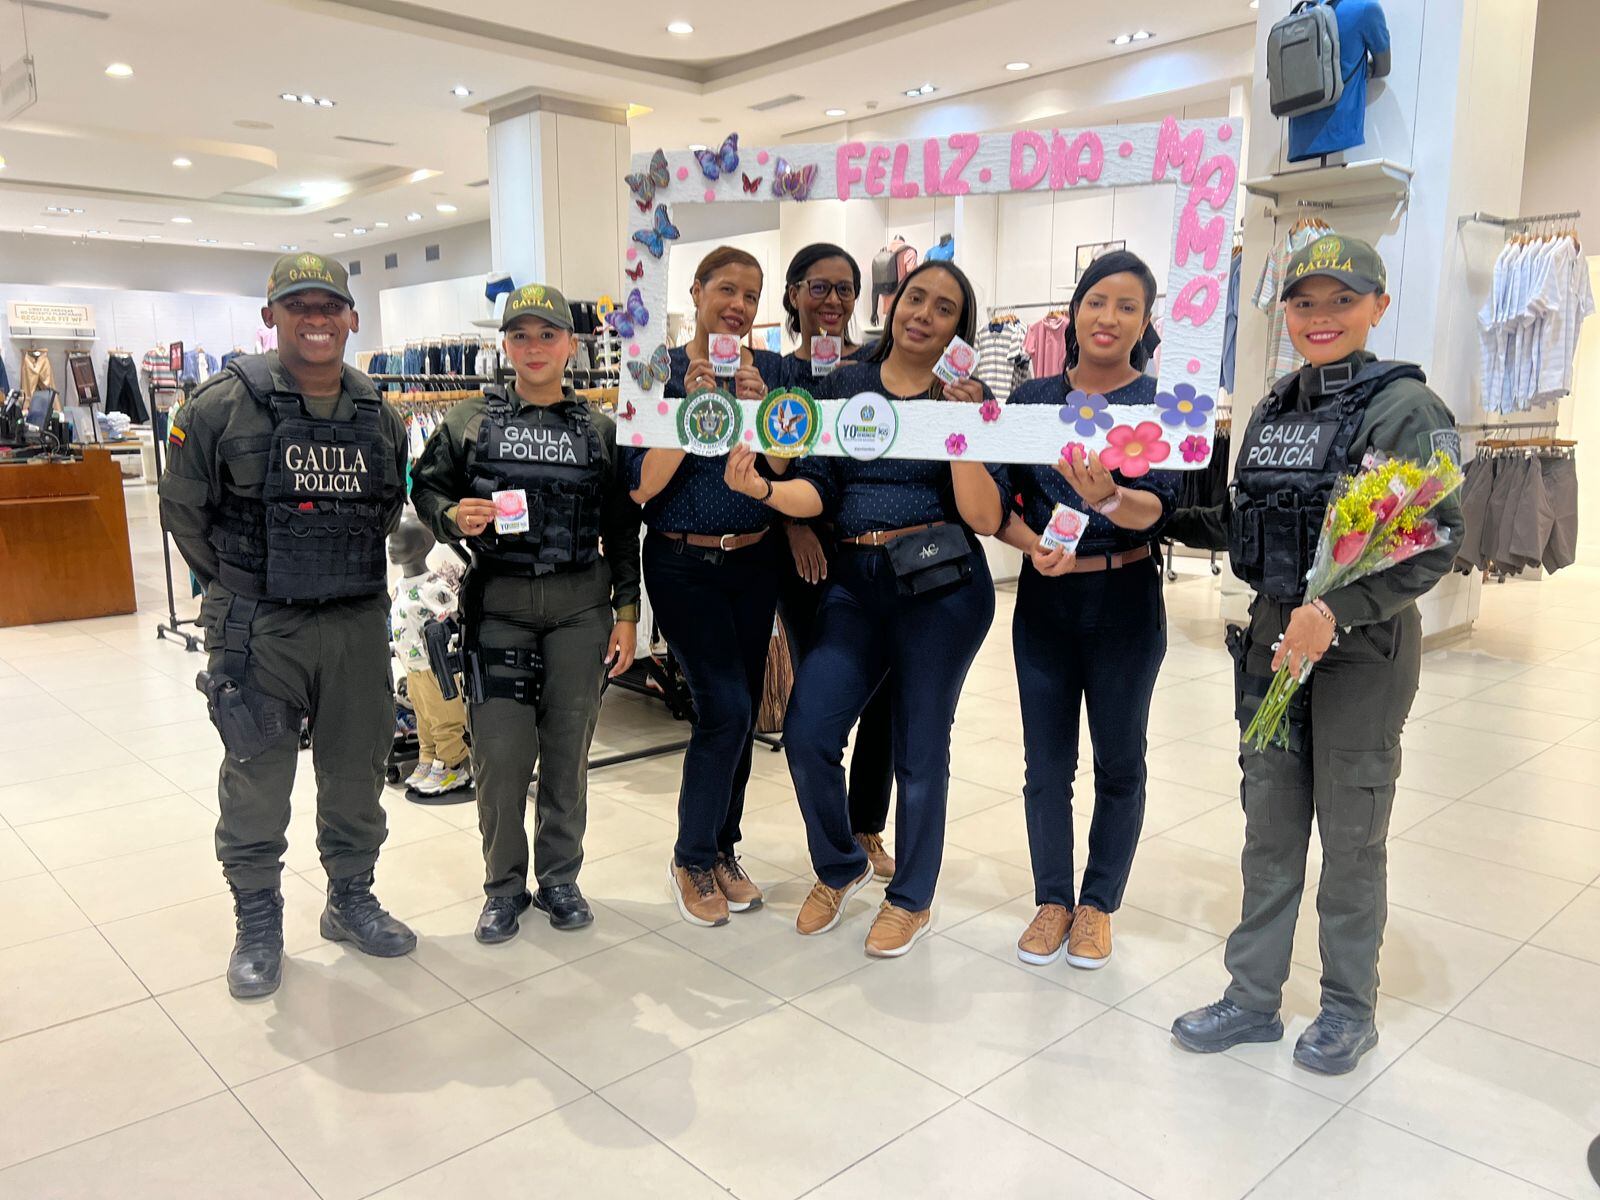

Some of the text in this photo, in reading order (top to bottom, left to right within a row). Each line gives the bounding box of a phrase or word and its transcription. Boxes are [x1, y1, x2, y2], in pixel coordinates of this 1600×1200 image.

[836, 133, 980, 201] FELIZ
[289, 269, 334, 284] GAULA
[1296, 257, 1353, 277] GAULA
[512, 298, 554, 310] GAULA
[20, 314, 57, 322] REGULAR
[504, 426, 573, 446] GAULA
[843, 424, 857, 438] YO
[1259, 425, 1320, 444] GAULA
[285, 444, 368, 473] GAULA
[499, 442, 578, 463] POLICÍA
[1246, 444, 1314, 467] POLICÍA
[294, 473, 362, 492] POLICIA
